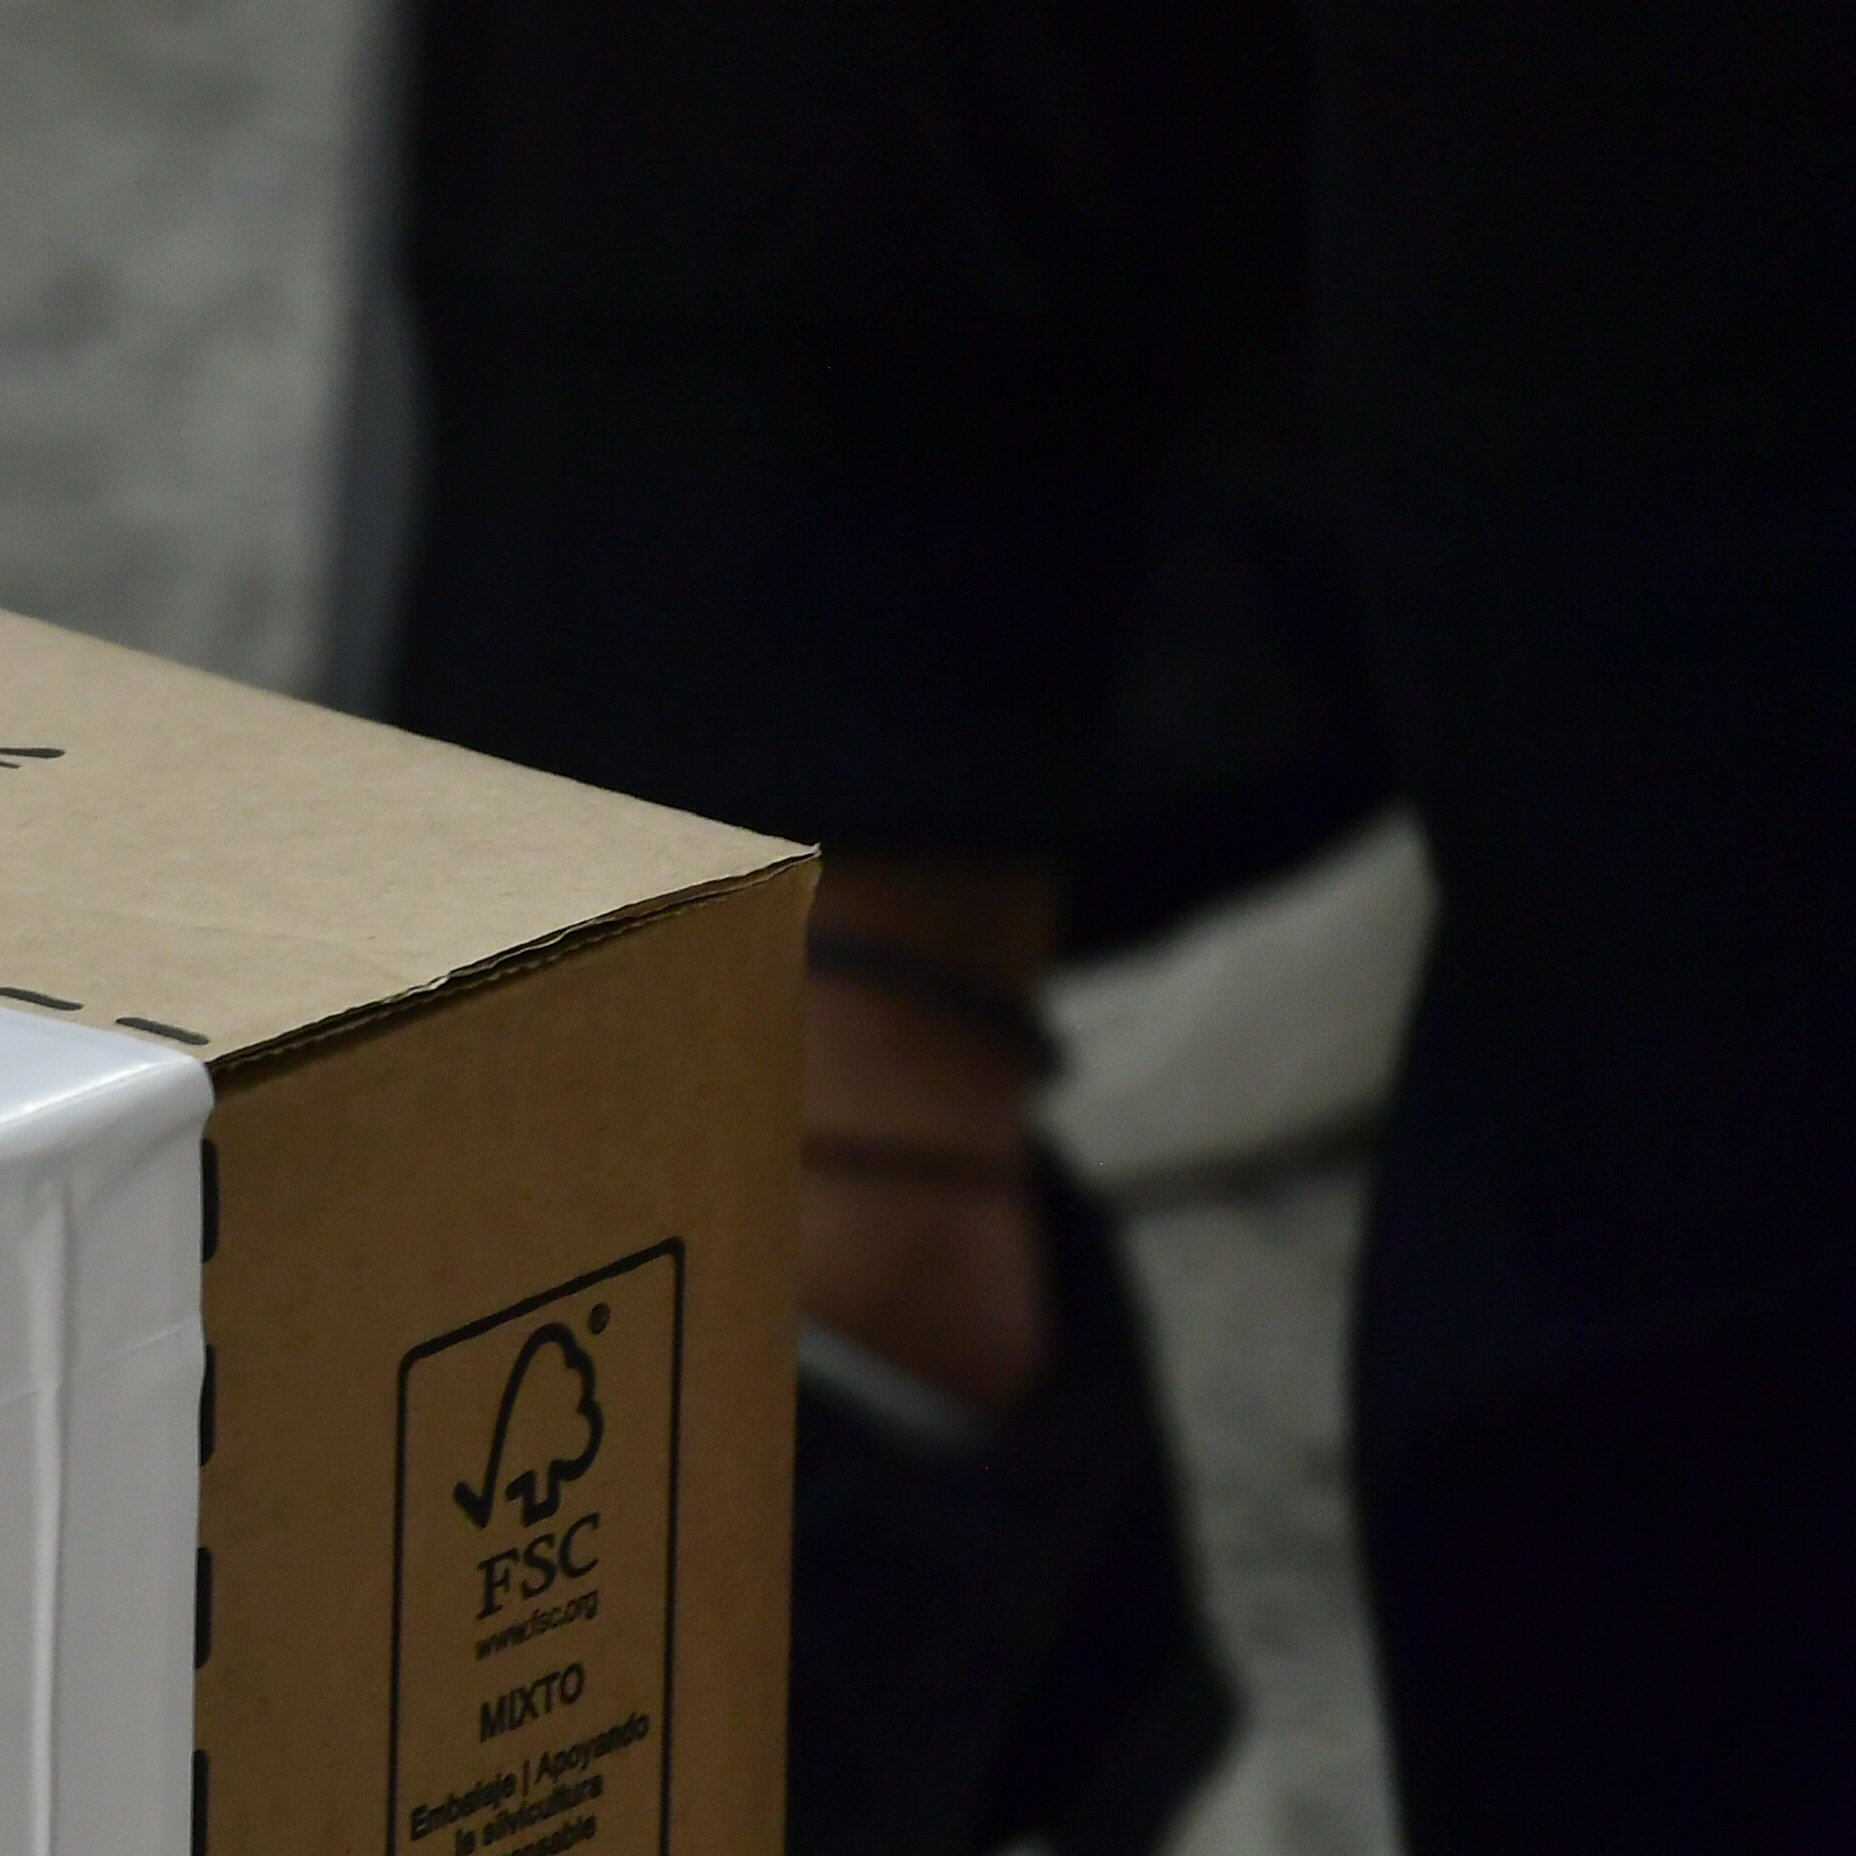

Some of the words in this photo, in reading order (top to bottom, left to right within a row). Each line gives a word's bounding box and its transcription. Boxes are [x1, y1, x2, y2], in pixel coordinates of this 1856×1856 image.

[475, 1512, 600, 1621] FSC
[479, 1662, 586, 1744] MIXTO
[409, 1772, 517, 1843] Embalaje
[536, 1712, 650, 1785] Apoyando
